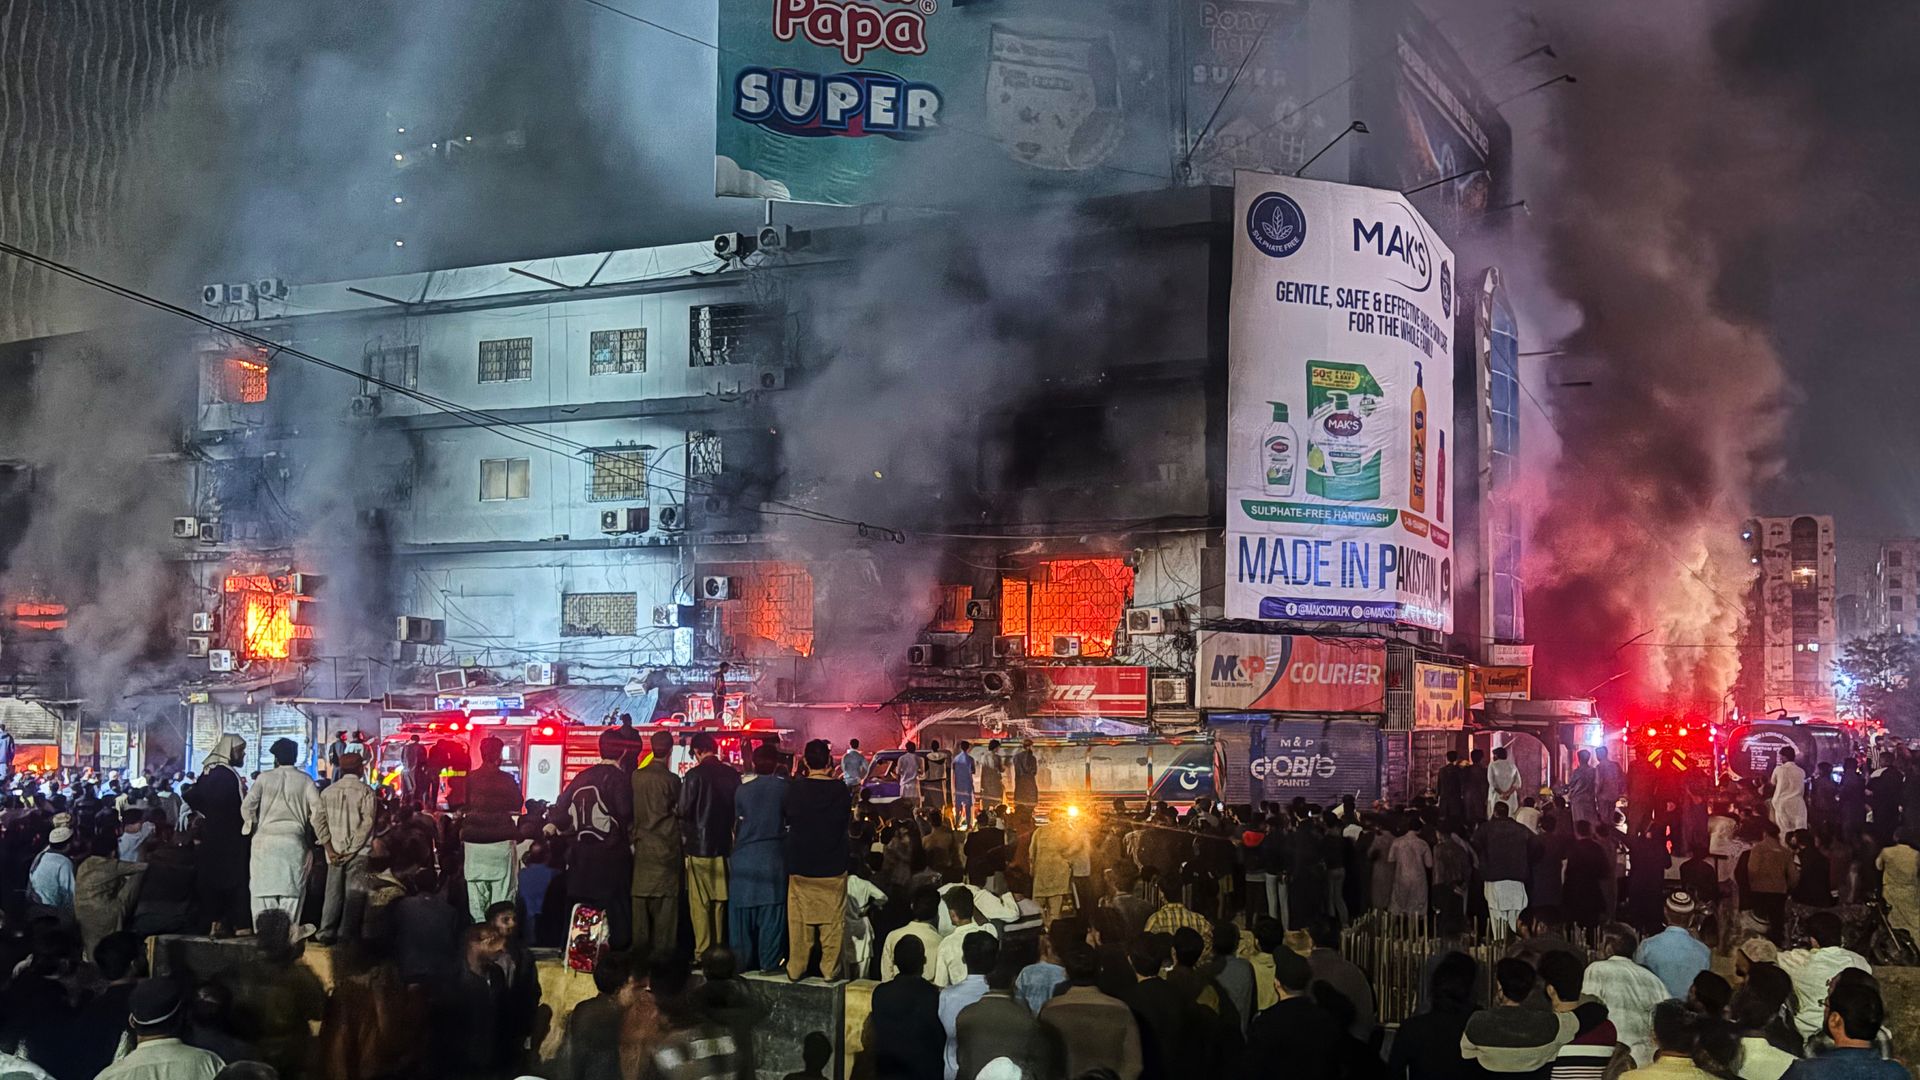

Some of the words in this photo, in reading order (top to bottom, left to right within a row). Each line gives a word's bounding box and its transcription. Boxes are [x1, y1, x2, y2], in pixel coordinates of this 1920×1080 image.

[773, 0, 928, 65] Papa
[738, 70, 943, 131] SUPER
[1252, 229, 1284, 252] SULPHATE
[1284, 236, 1300, 252] FREE
[1352, 217, 1428, 278] MAK'S
[1276, 281, 1333, 309] GENTLE,
[1336, 287, 1370, 311] SAFE
[1373, 292, 1381, 312] &
[1384, 294, 1420, 327] EFFECTIVE
[1349, 312, 1374, 334] FOR
[1377, 315, 1399, 338] THE
[1400, 319, 1420, 349] WHOLE
[1328, 418, 1360, 431] MAK'S
[1250, 504, 1331, 520] SULPHATE-FREE
[1333, 508, 1389, 523] HANDWASH
[1238, 535, 1331, 588] MADE
[1341, 541, 1369, 588] IN
[1378, 543, 1438, 605] PAKISTAN
[1211, 654, 1265, 682] M&P
[1289, 661, 1381, 686] COURIER
[1053, 684, 1097, 700] TCS
[1280, 739, 1291, 748] M
[1293, 736, 1302, 747] &
[1305, 739, 1314, 747] P
[1277, 779, 1311, 788] PAINTS
